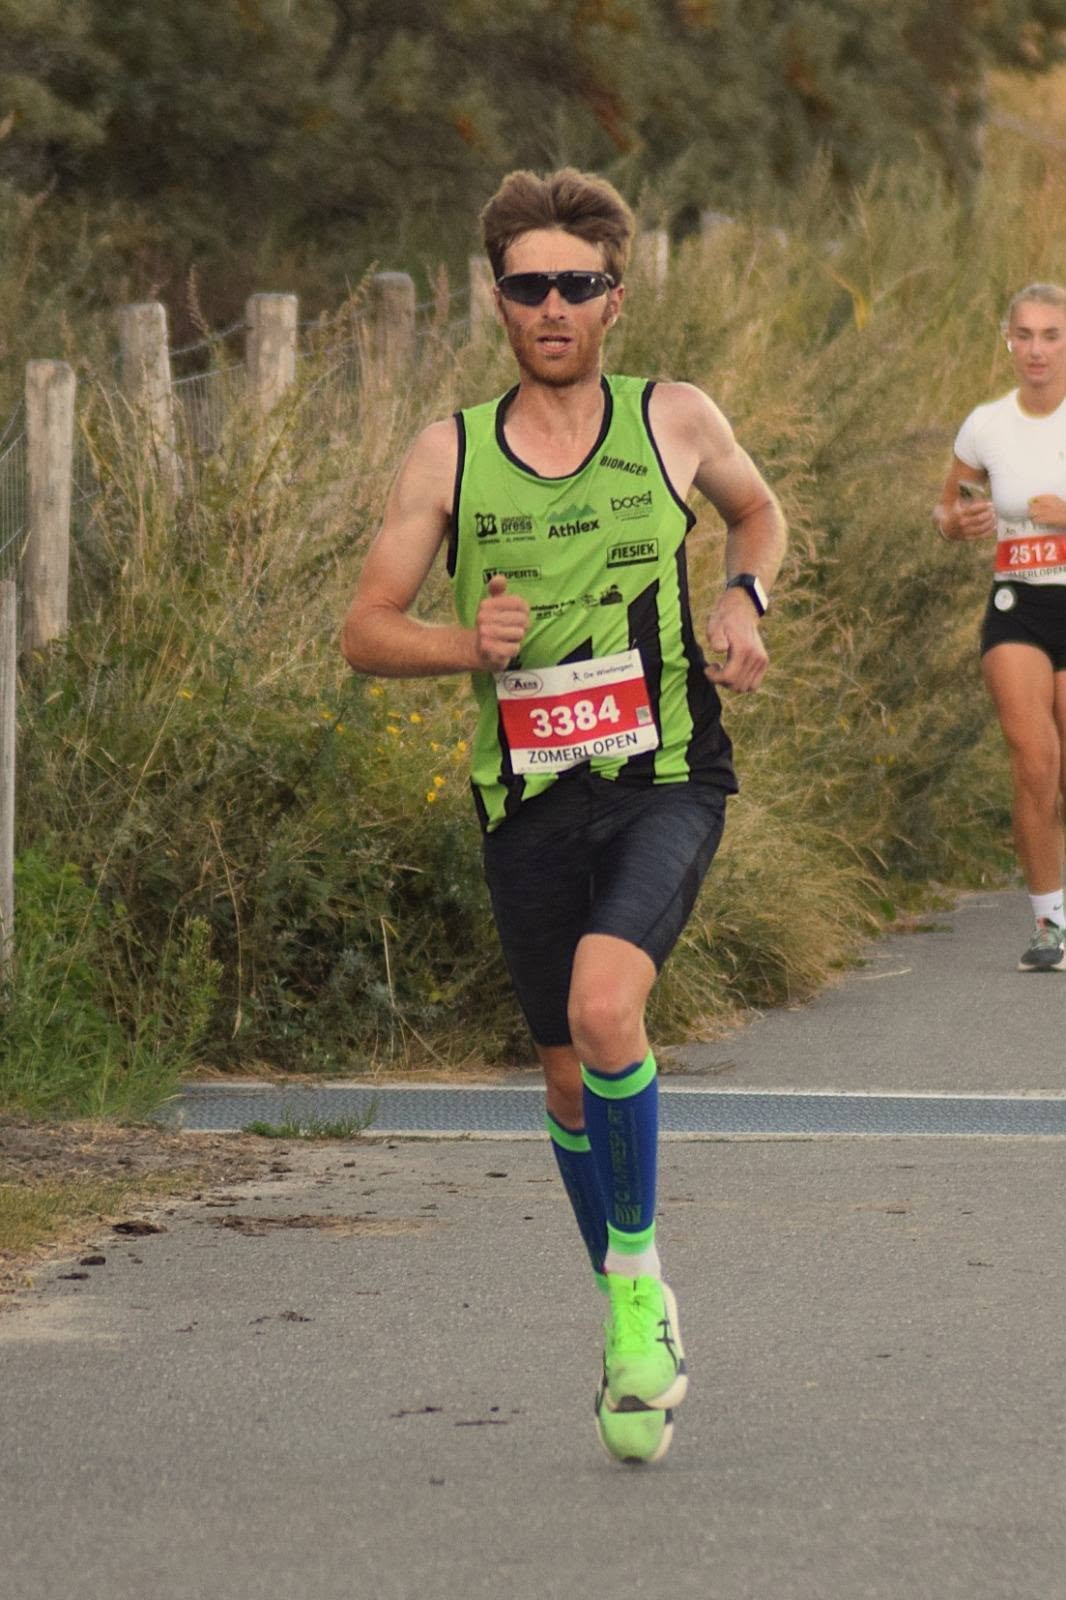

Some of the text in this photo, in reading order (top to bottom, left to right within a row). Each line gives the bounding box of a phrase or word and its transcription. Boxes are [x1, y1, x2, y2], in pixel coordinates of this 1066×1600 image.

[600, 455, 648, 477] BIORACER
[548, 519, 600, 539] Athlex
[611, 543, 654, 561] FIESIEK
[1009, 542, 1057, 565] 2512
[529, 694, 621, 738] 3384
[528, 731, 638, 764] ZOMERLOPEN
